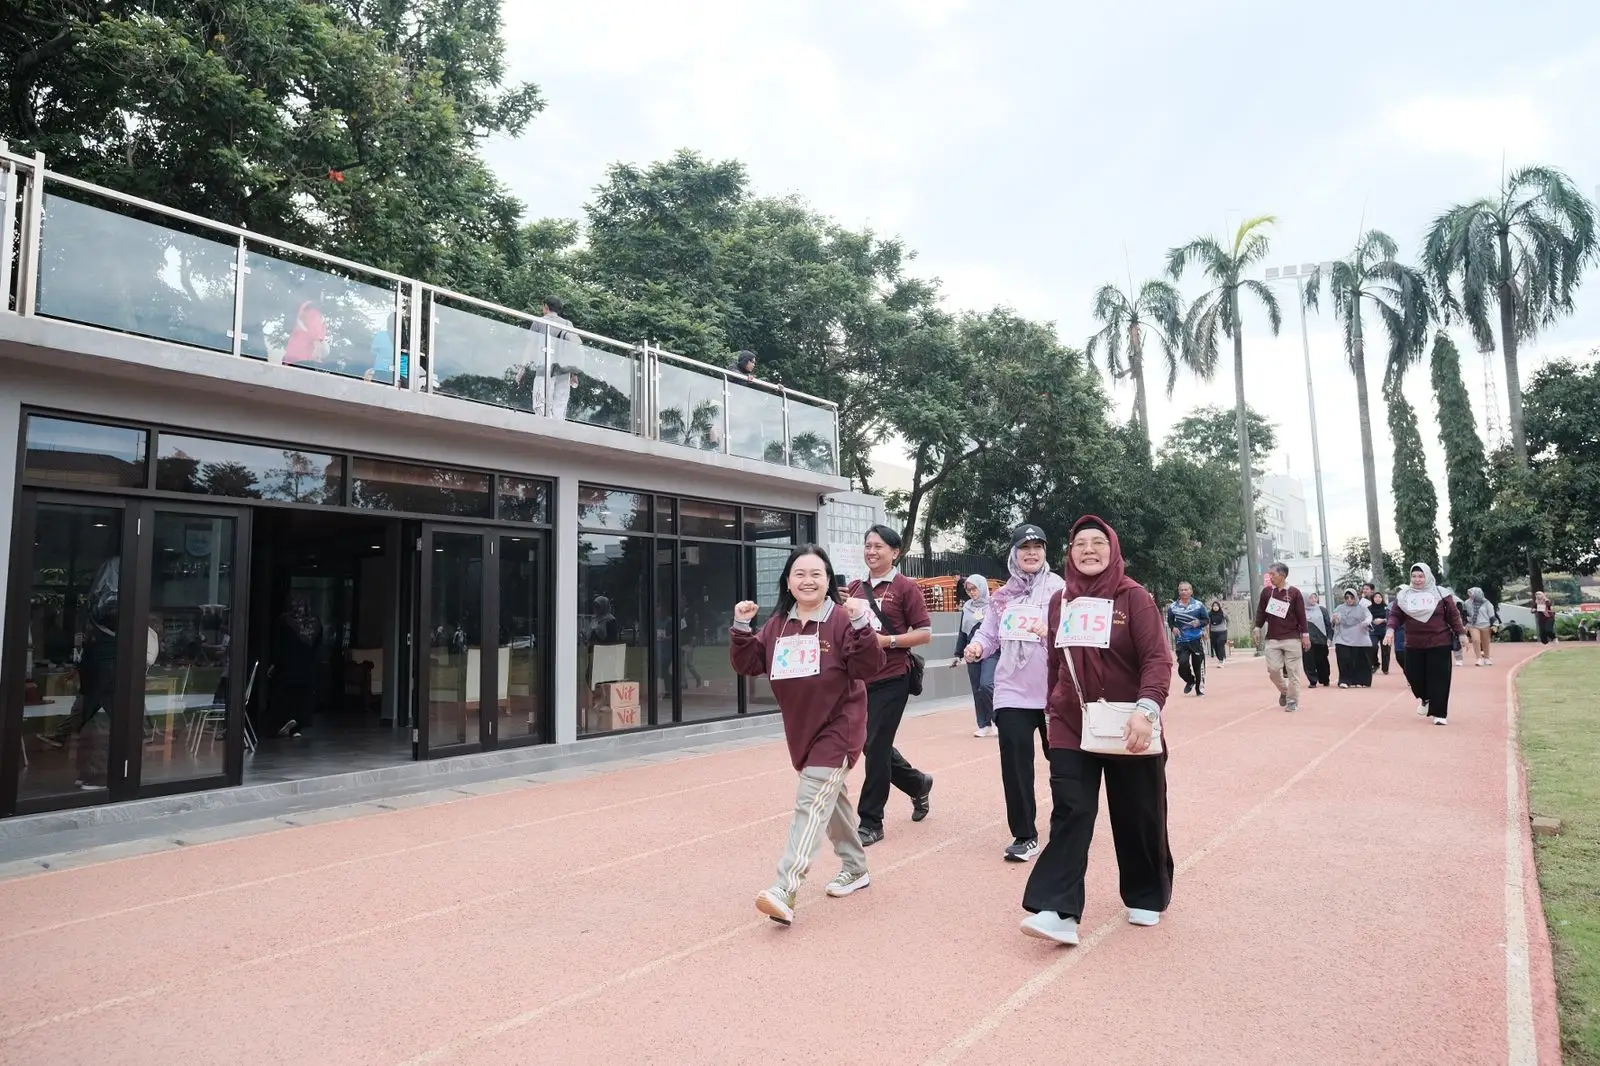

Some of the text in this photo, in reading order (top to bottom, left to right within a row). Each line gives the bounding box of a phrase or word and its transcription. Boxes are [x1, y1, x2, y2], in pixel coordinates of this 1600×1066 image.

[1018, 615, 1039, 629] 27
[1080, 613, 1106, 632] 15
[800, 648, 817, 664] 13
[616, 685, 635, 701] Vit
[617, 709, 637, 724] Vit
